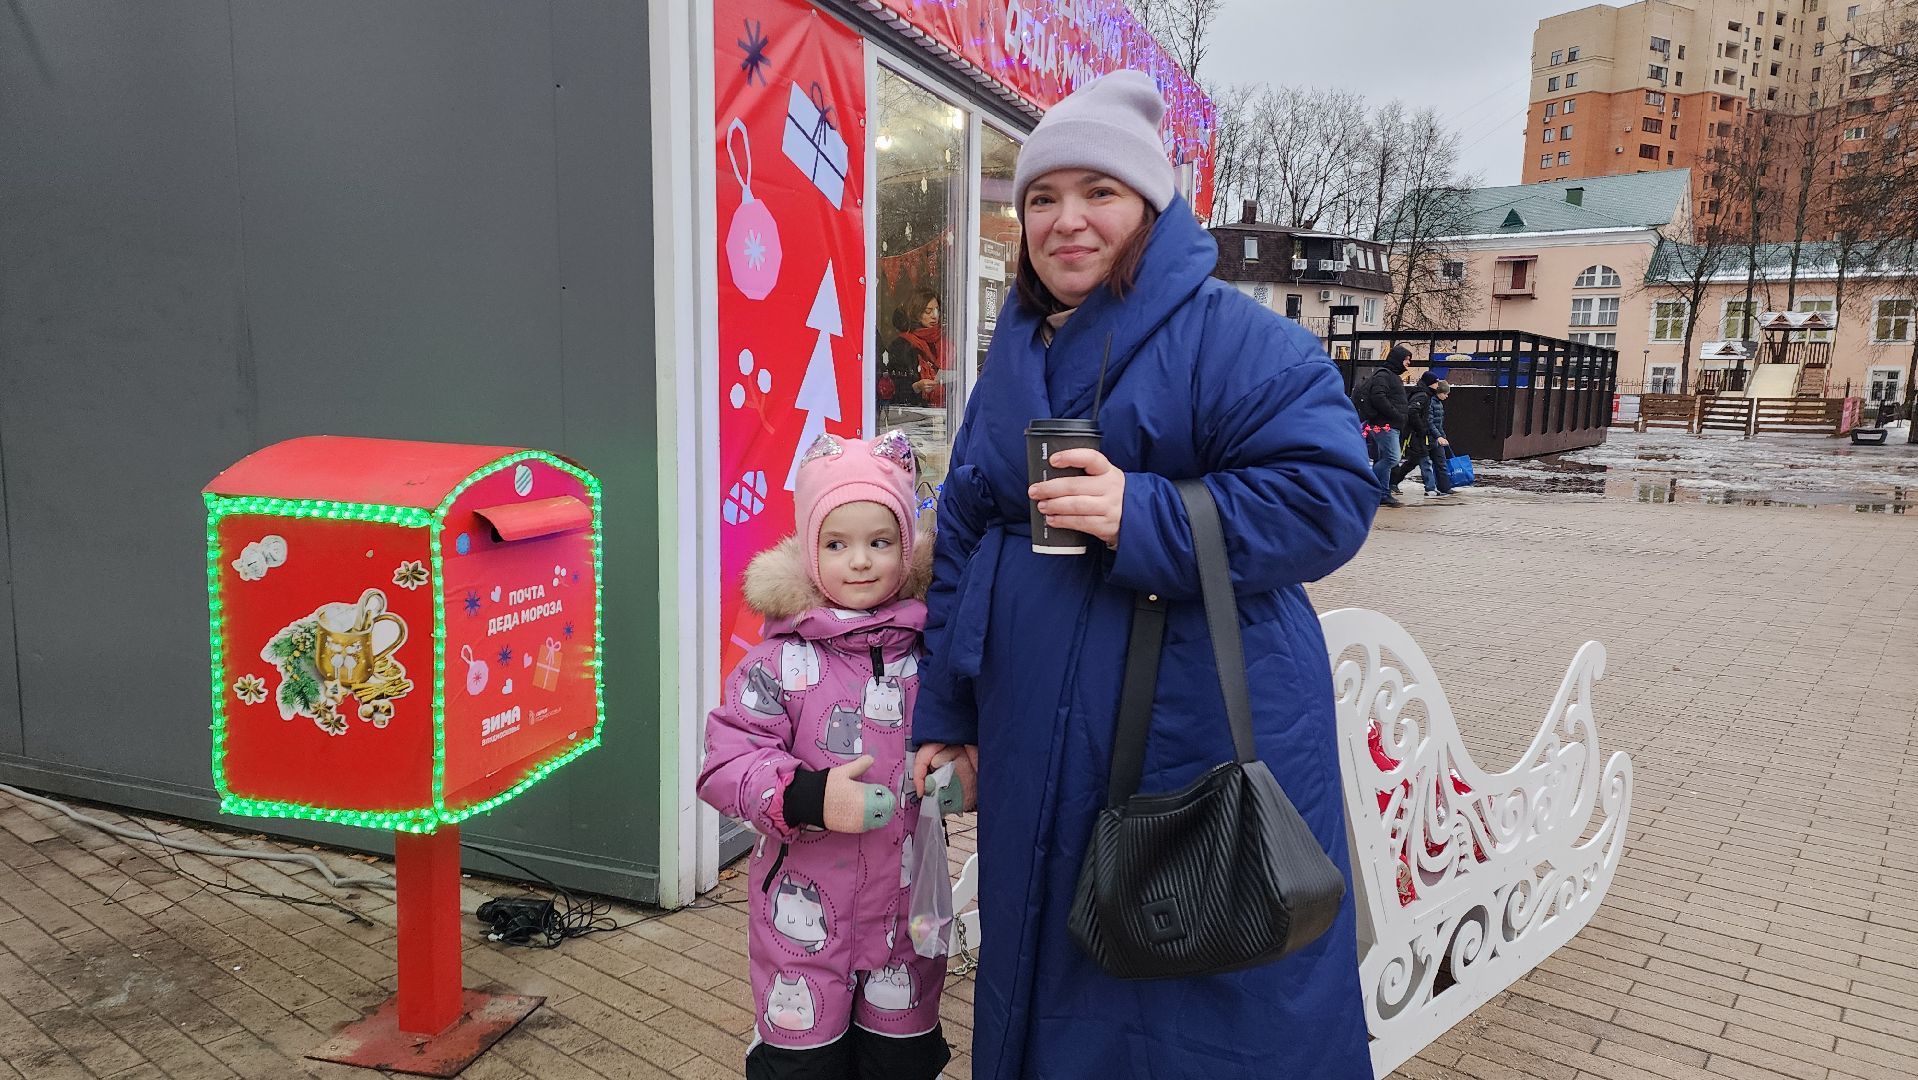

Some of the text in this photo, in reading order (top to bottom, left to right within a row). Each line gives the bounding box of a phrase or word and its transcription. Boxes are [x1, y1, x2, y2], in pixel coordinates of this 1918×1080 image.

[1004, 0, 1058, 80] ДЕДА
[508, 584, 546, 606] ПОЧТА
[487, 599, 563, 637] ДЕДА МОРОЗА
[481, 705, 521, 737] ЗИМА
